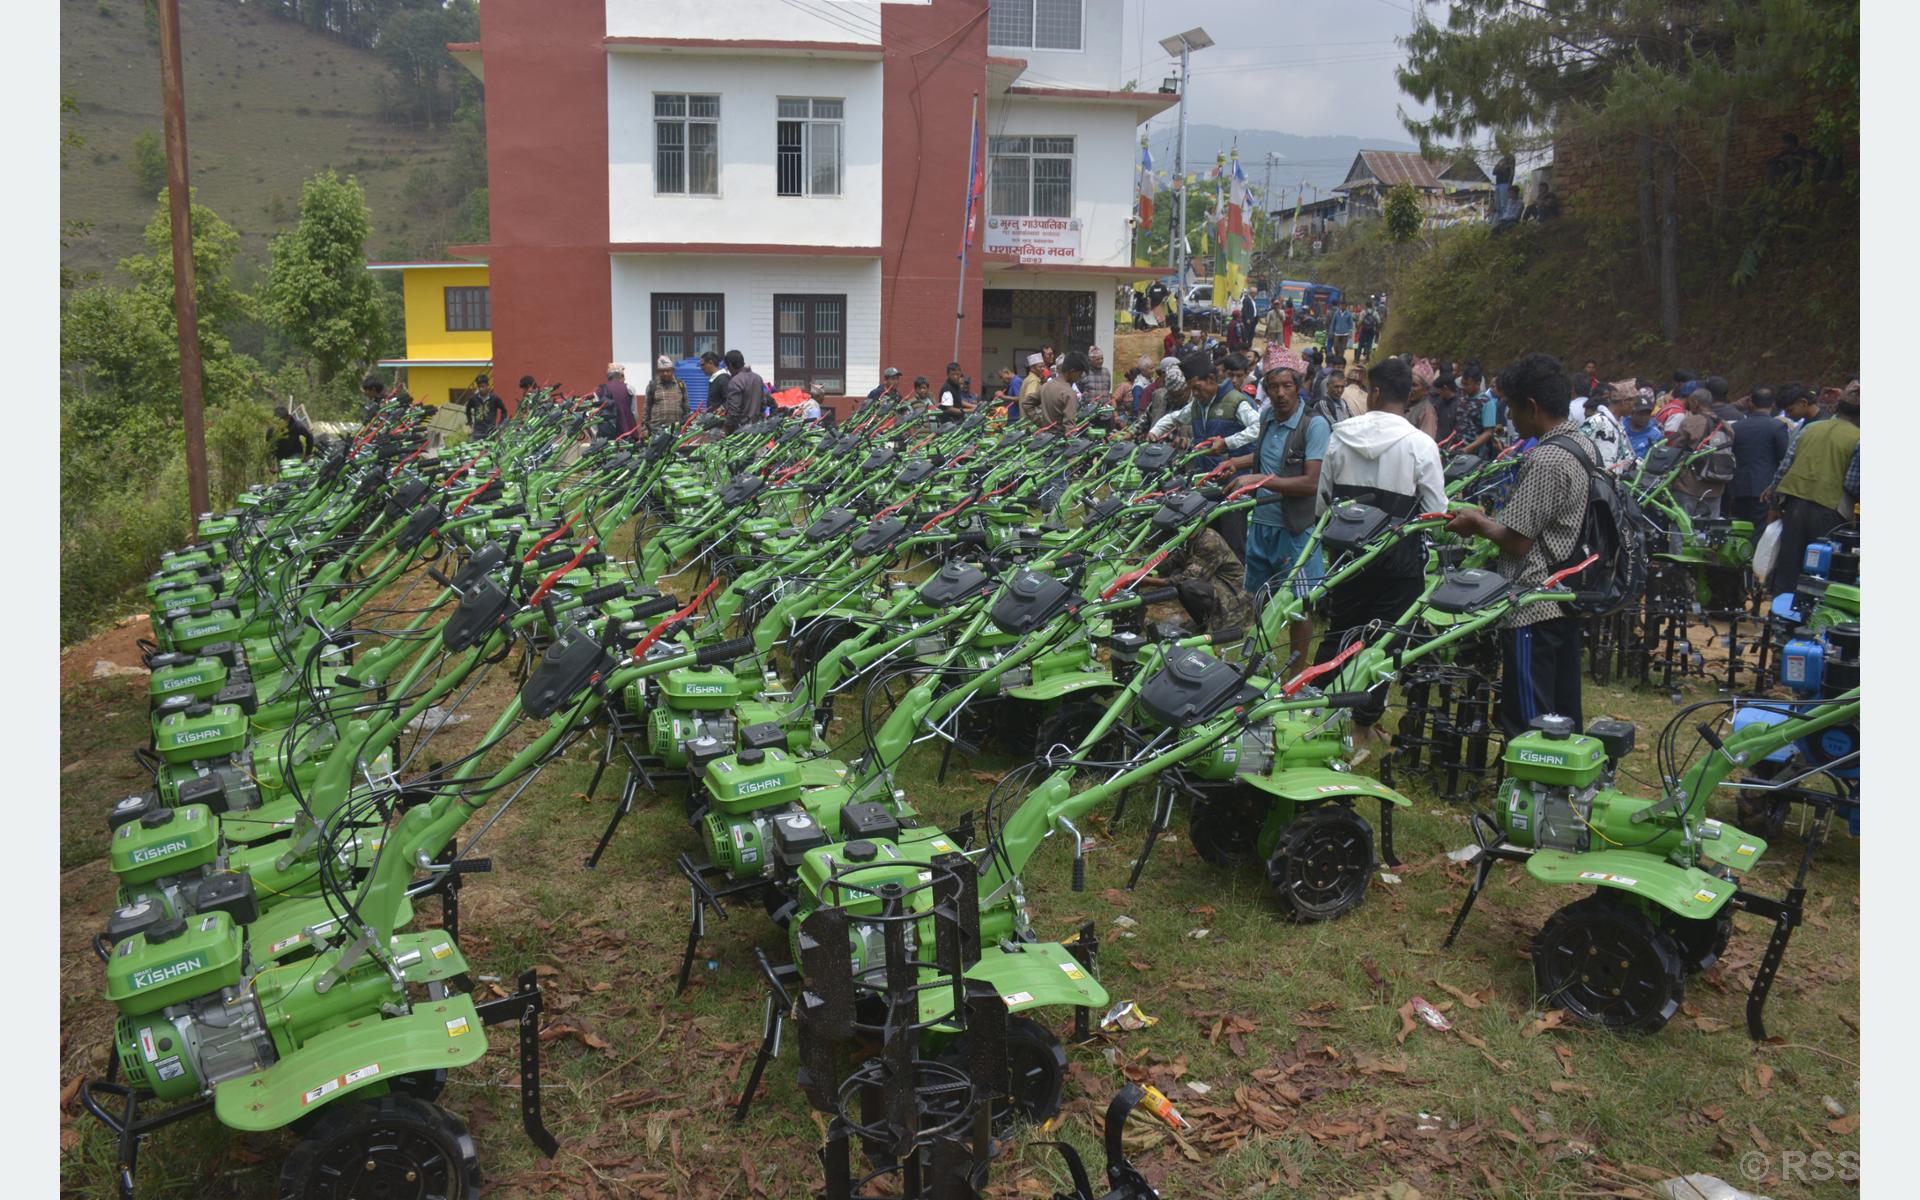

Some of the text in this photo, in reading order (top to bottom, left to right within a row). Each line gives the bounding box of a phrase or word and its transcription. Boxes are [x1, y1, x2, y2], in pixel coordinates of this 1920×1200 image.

[686, 686, 722, 694] KISHAN
[176, 728, 221, 744] KISHAN
[1520, 752, 1563, 764] KISHAN
[738, 778, 781, 794] KISHAN
[133, 839, 188, 863] KISHAN
[135, 957, 202, 989] KISHAN
